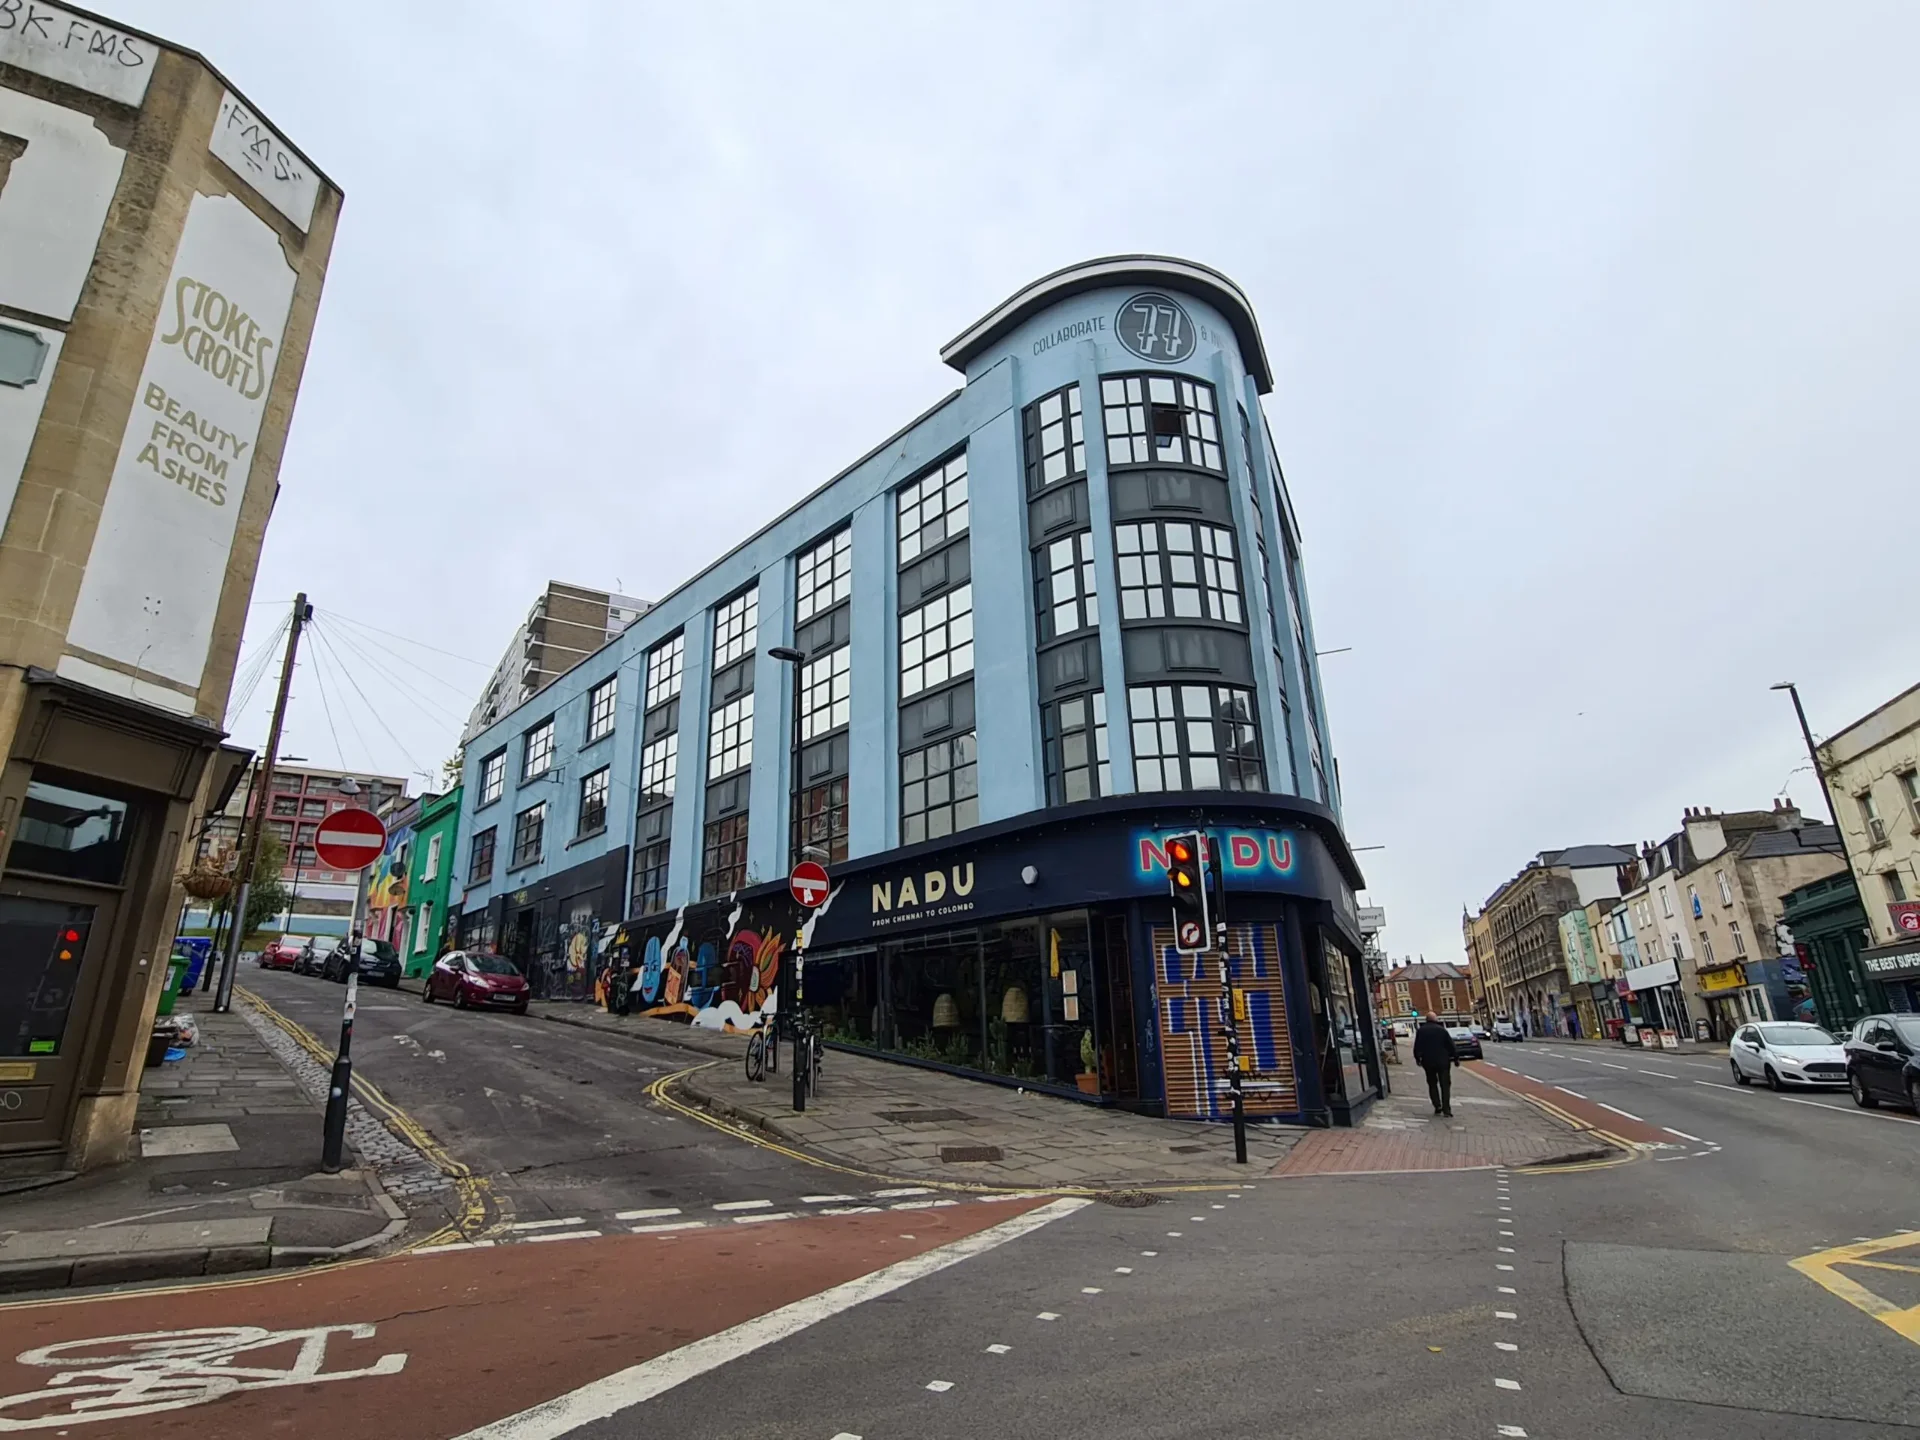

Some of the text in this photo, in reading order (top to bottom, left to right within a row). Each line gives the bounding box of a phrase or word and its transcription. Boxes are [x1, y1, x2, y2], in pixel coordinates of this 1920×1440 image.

[1033, 316, 1105, 356] COLLABORATE
[1132, 303, 1182, 356] 77
[143, 382, 249, 460] BEAUTY
[136, 442, 227, 506] ASHES
[150, 420, 229, 480] FROM
[872, 862, 974, 913] NADU
[872, 902, 974, 927] FROM CHENNAI TO COLOMBO
[1865, 959, 1881, 972] THE
[1881, 956, 1898, 971] BEST
